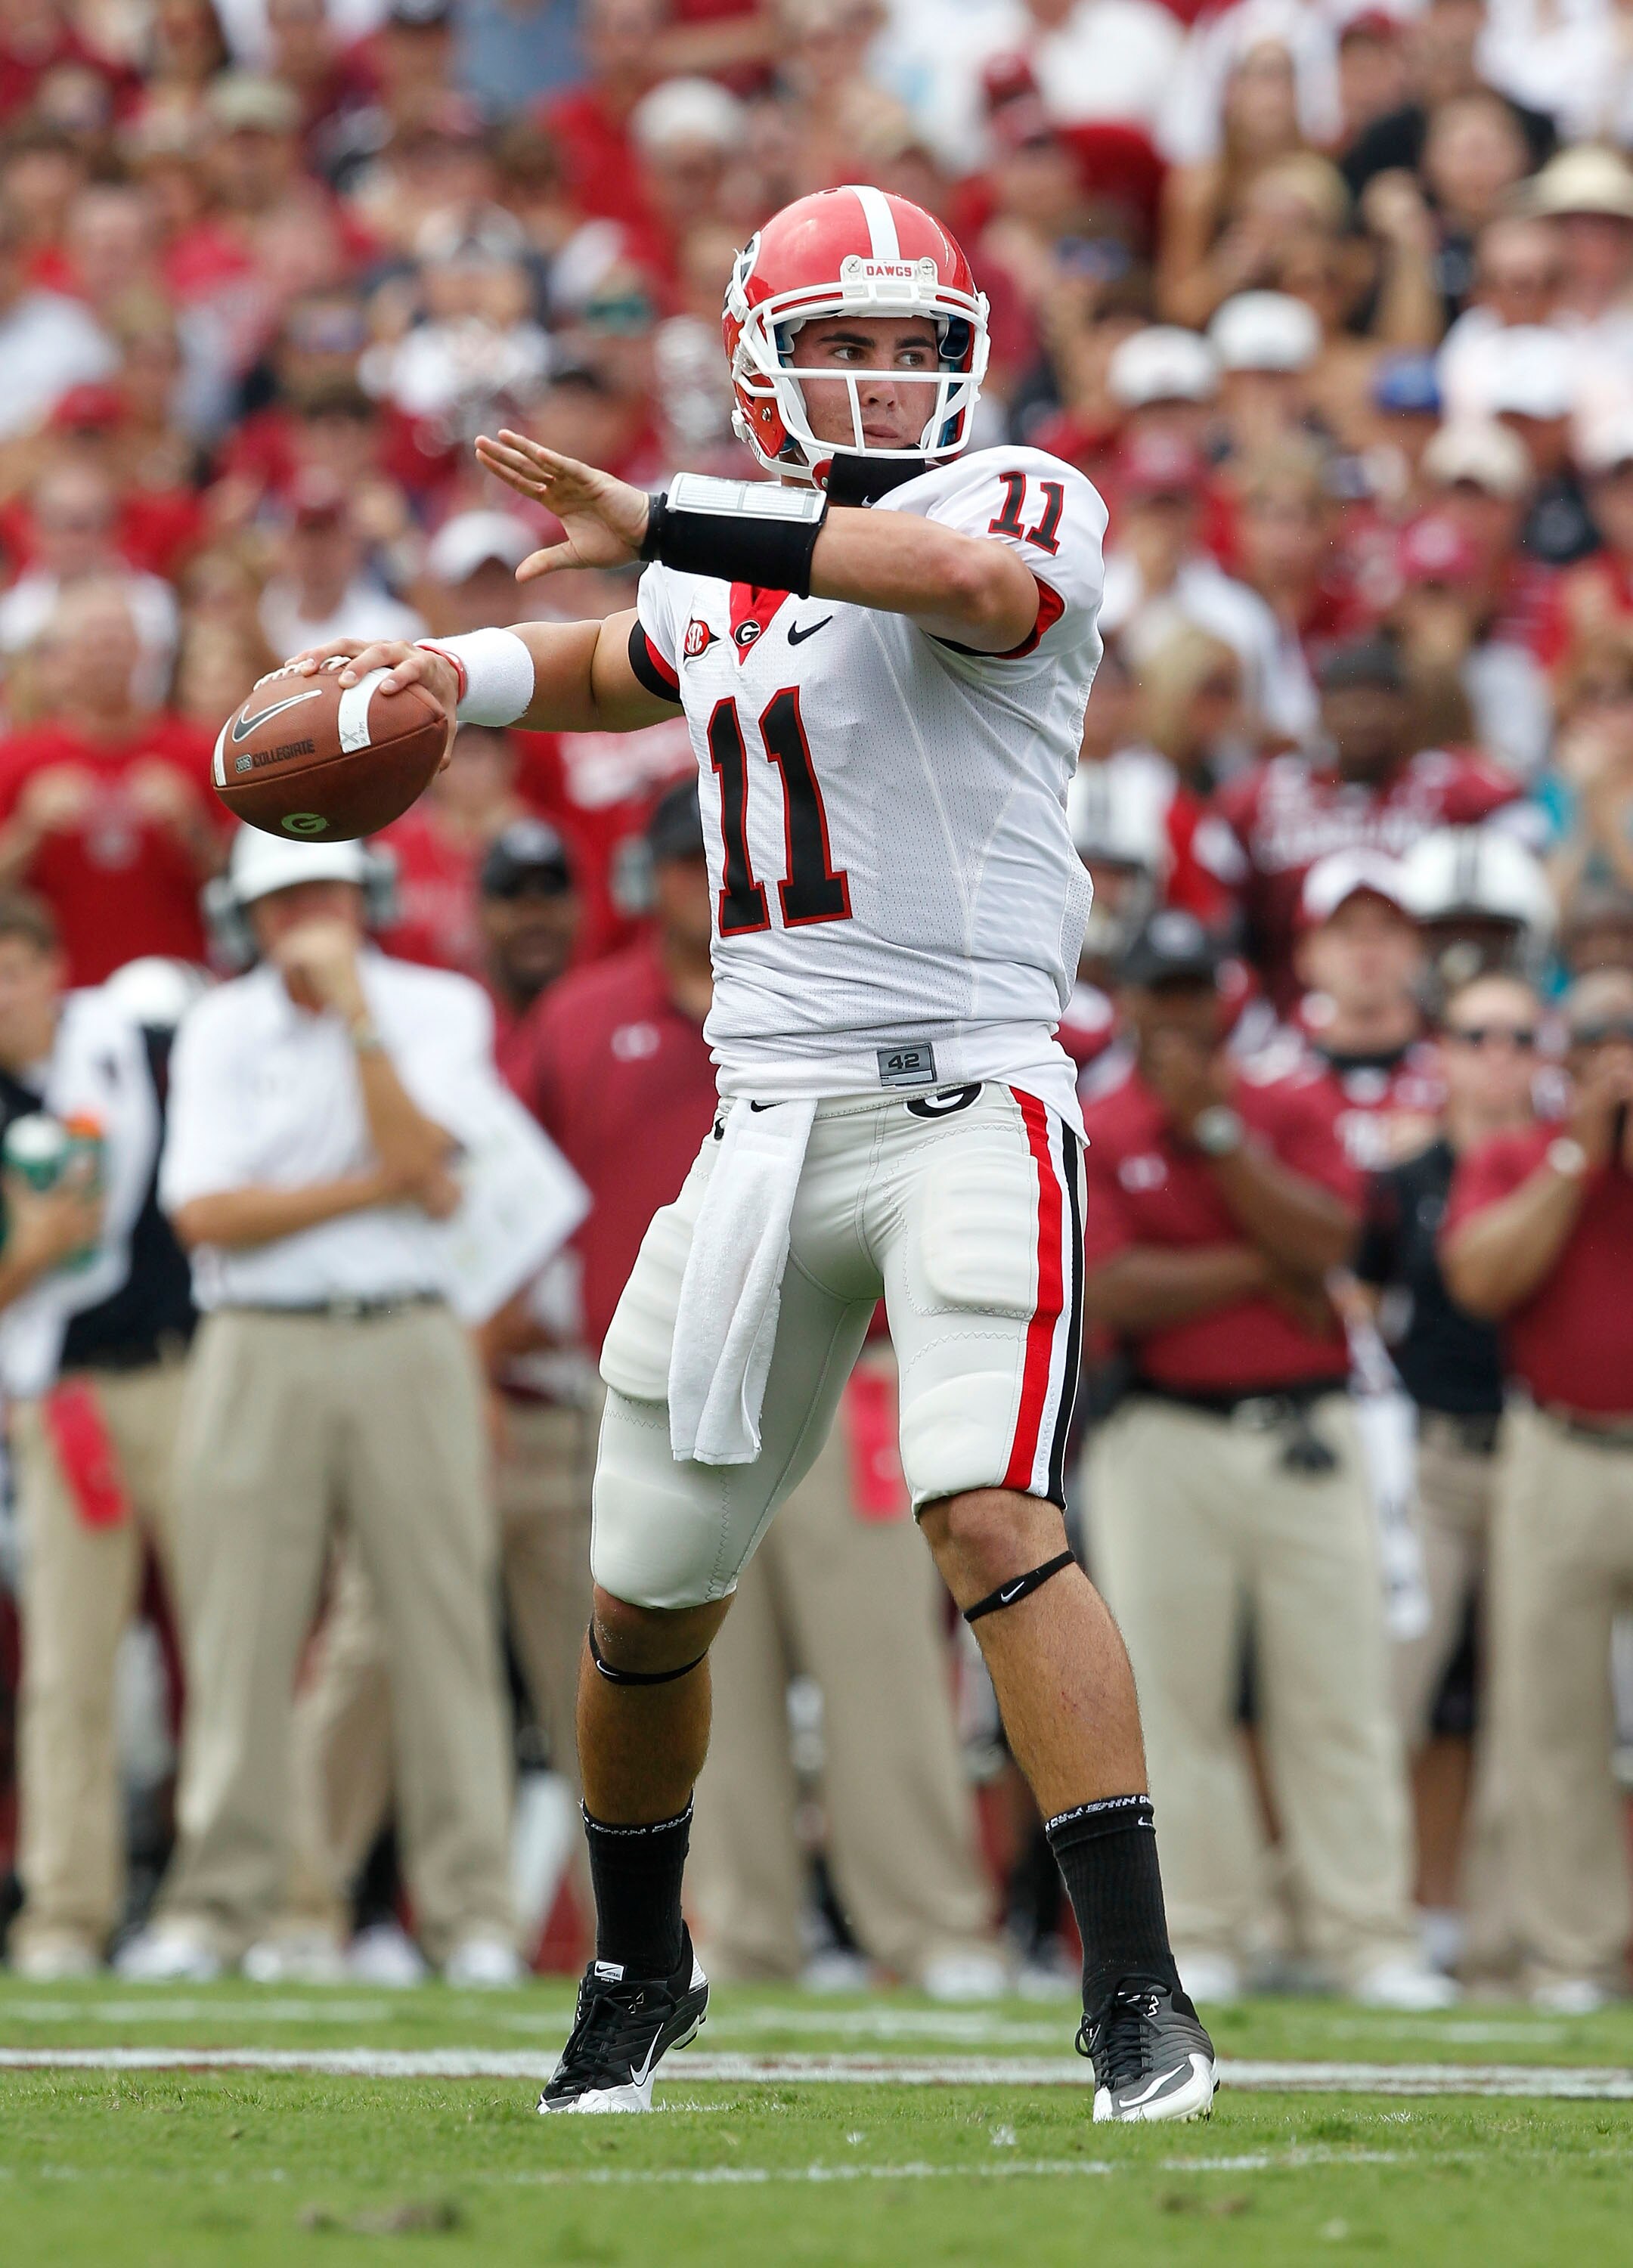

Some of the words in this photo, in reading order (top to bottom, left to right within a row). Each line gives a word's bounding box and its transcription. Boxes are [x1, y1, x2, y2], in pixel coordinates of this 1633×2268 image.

[866, 265, 912, 277] DAWGS
[988, 471, 1064, 556] 11
[686, 622, 703, 653] SEC
[735, 621, 761, 646] G
[253, 739, 315, 768] COLLEGIATE
[281, 813, 327, 835] G
[706, 685, 851, 938] 11
[888, 1053, 919, 1069] 42
